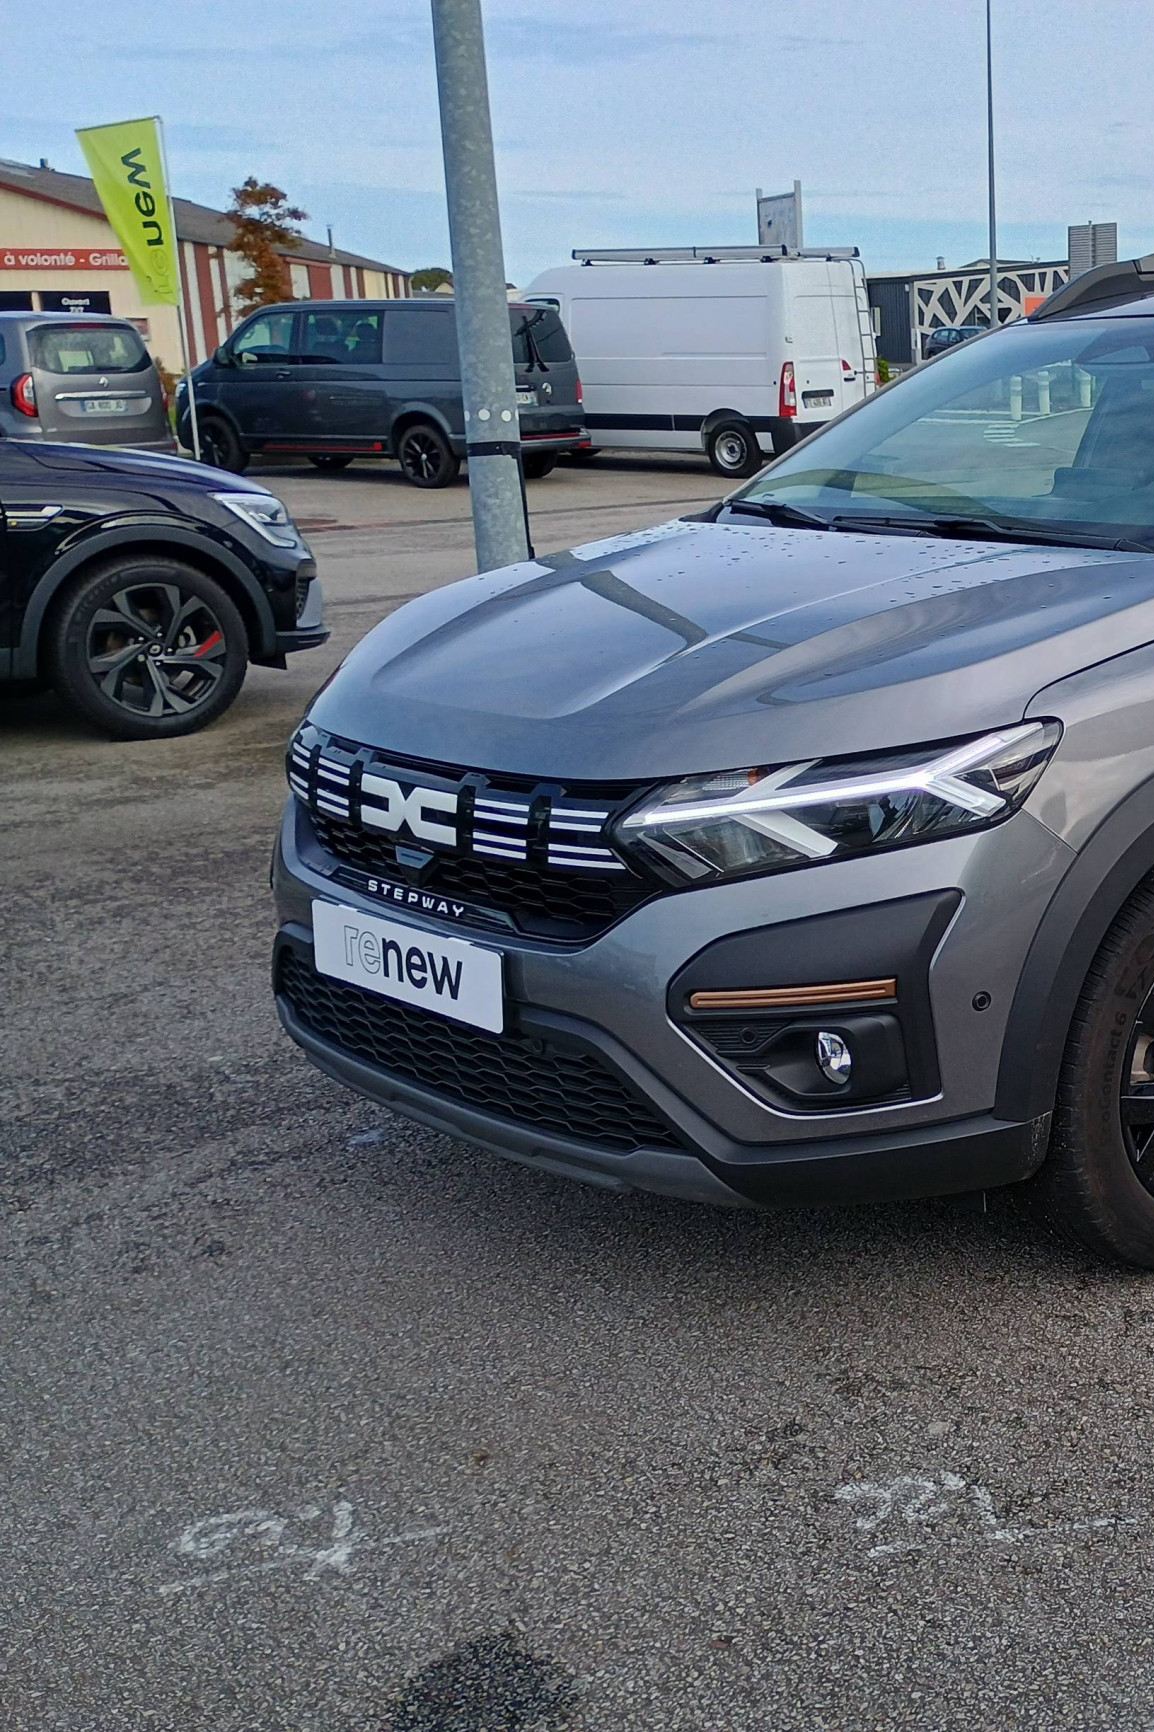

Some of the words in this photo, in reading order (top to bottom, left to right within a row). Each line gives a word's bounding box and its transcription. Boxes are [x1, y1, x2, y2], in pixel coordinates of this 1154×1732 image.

[4, 251, 15, 266] à
[19, 251, 75, 266] volonté
[367, 879, 465, 918] STEPWAY
[343, 925, 464, 1001] renew
